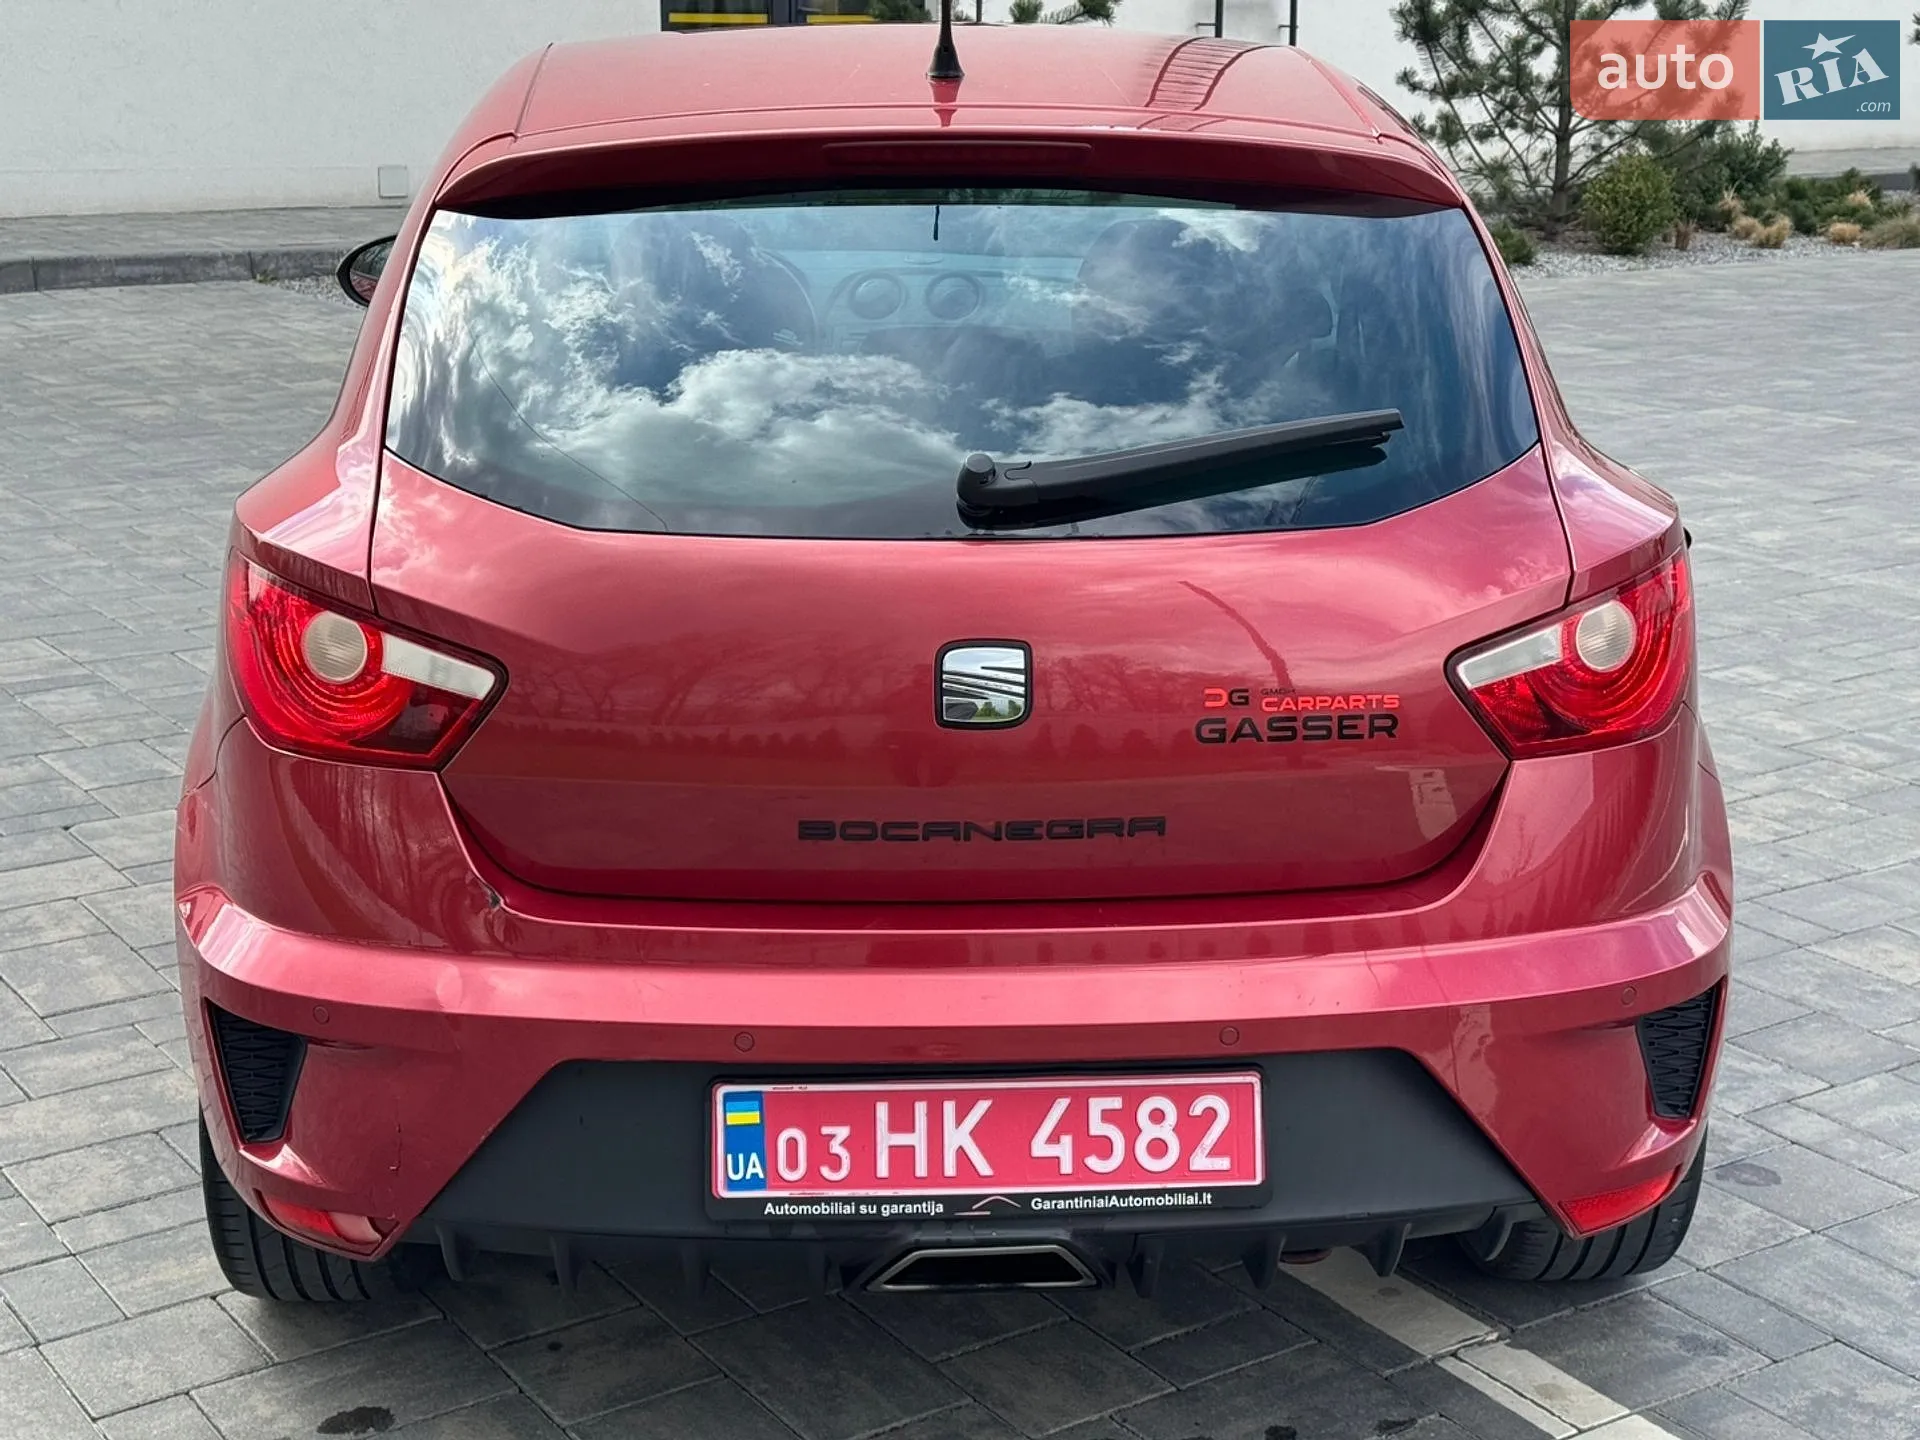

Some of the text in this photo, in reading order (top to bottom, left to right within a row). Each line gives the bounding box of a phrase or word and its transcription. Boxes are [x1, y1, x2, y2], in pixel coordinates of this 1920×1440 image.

[1261, 694, 1400, 712] CARPARTS
[1195, 713, 1399, 744] GASSER
[798, 816, 1166, 842] BOCANEGRA
[776, 1095, 1232, 1182] 03 HK 4582
[726, 1152, 765, 1181] UA
[764, 1201, 944, 1217] Automobiliai su garantija
